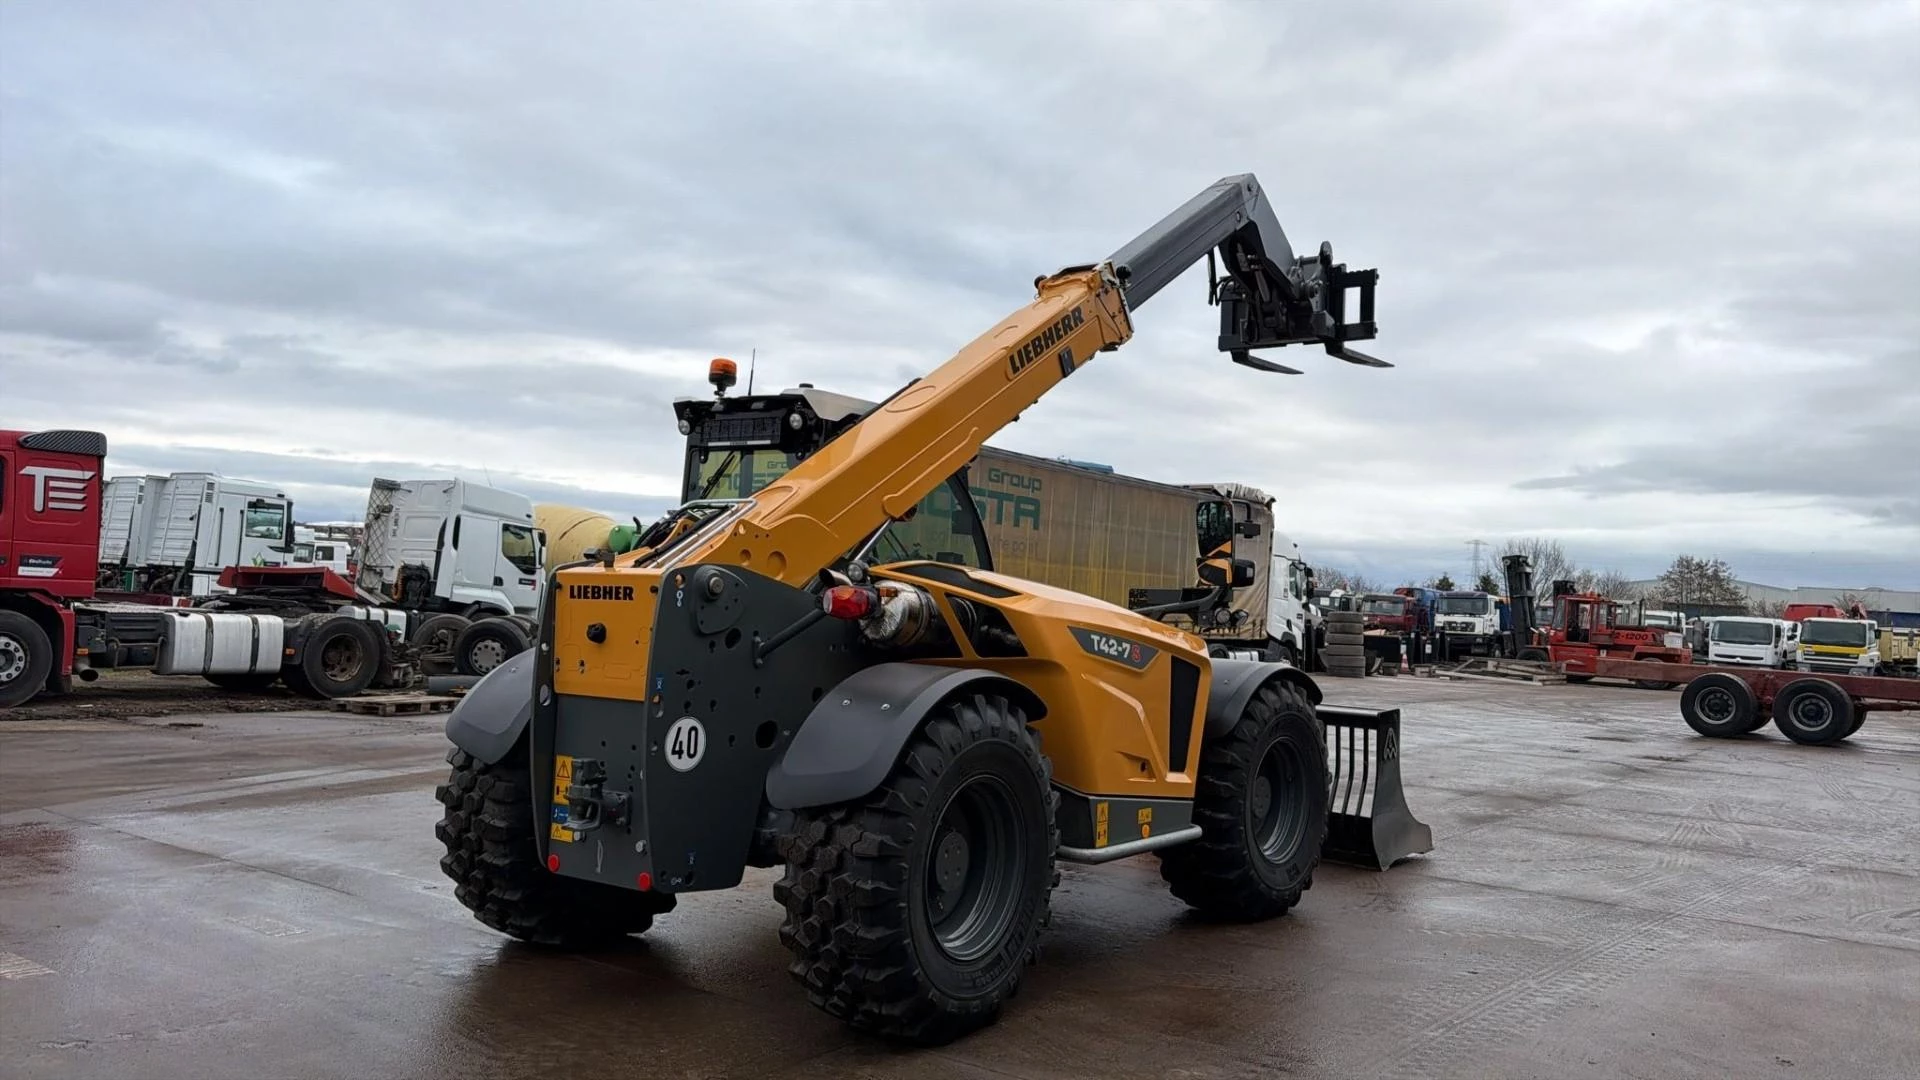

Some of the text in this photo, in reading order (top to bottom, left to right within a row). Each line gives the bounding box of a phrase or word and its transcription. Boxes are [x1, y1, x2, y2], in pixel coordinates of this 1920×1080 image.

[1009, 306, 1084, 375] LIEBHERR
[988, 468, 1042, 493] Group
[569, 584, 634, 601] LIEBHER
[671, 725, 699, 760] 40
